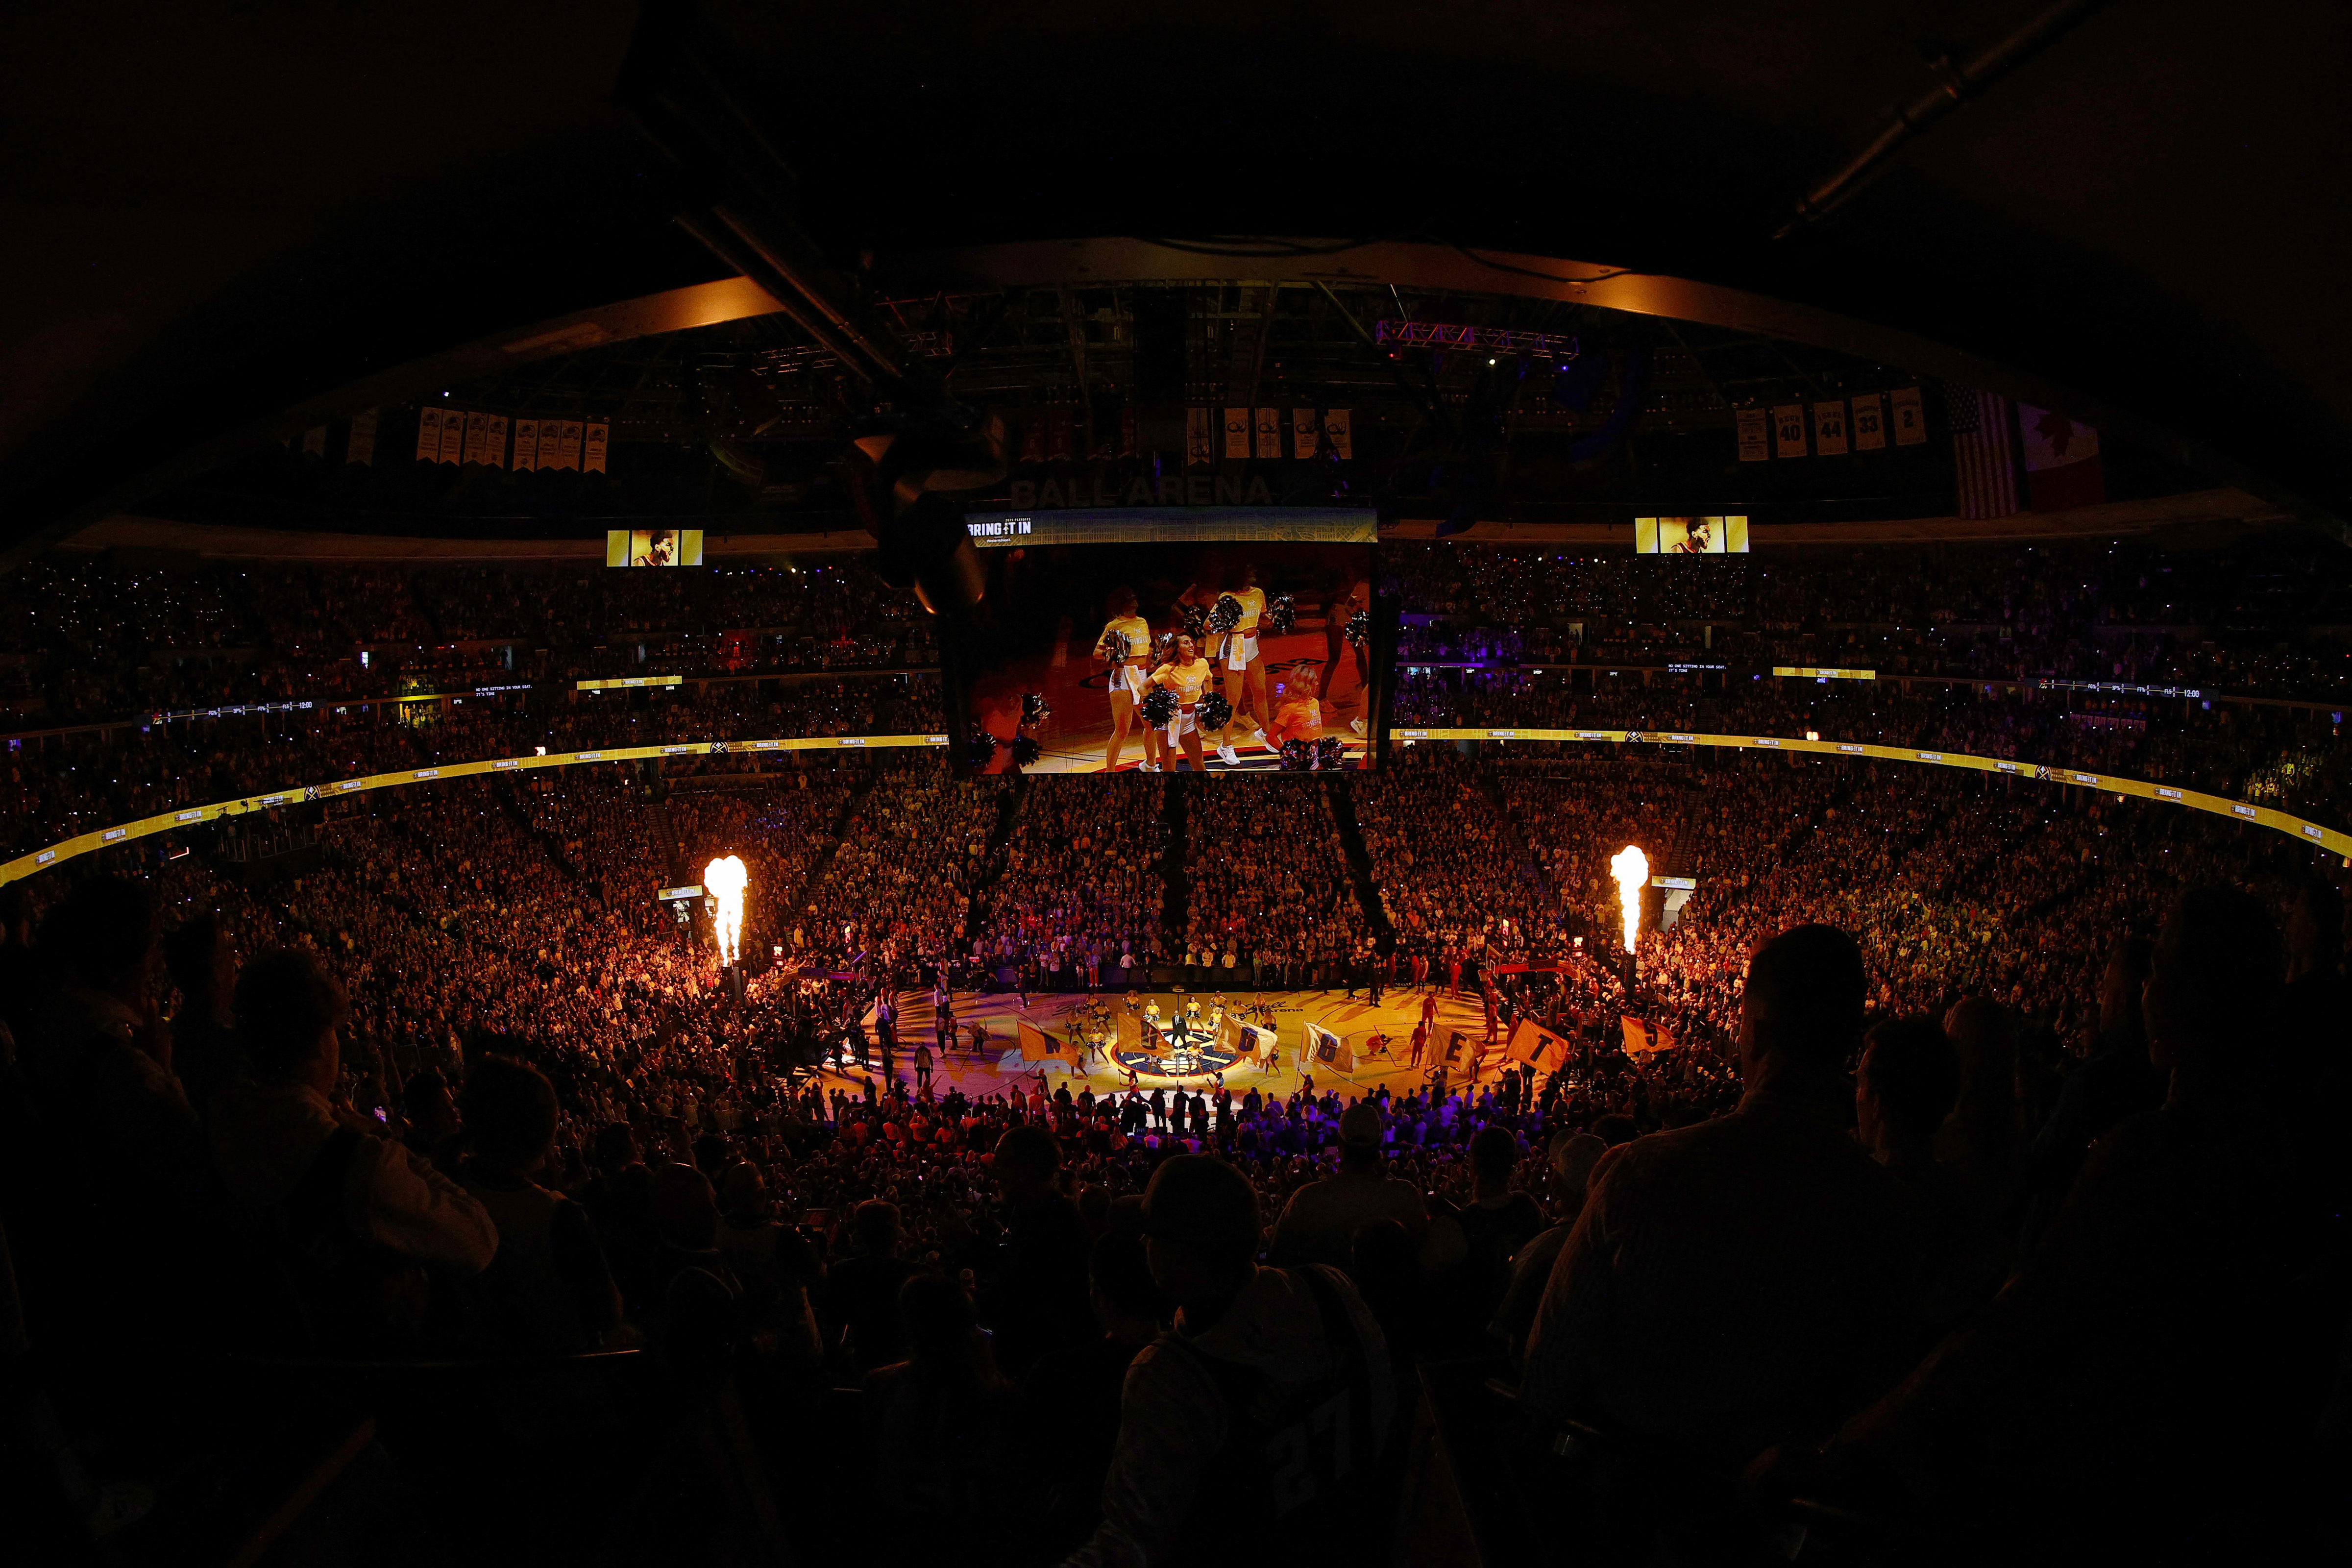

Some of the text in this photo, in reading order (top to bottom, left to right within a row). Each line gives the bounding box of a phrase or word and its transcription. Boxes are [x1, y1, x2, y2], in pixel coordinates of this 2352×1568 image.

[1859, 415, 1878, 433] 33
[1904, 410, 1913, 428] 2
[1780, 425, 1801, 441] 40
[1821, 421, 1841, 438] 44
[1011, 474, 1274, 510] BALL ARENA
[1017, 520, 1031, 534] IN
[2184, 689, 2199, 698] 12:00
[1445, 1031, 1467, 1062] E
[1529, 1033, 1553, 1062] T
[1264, 1386, 1352, 1520] 27
